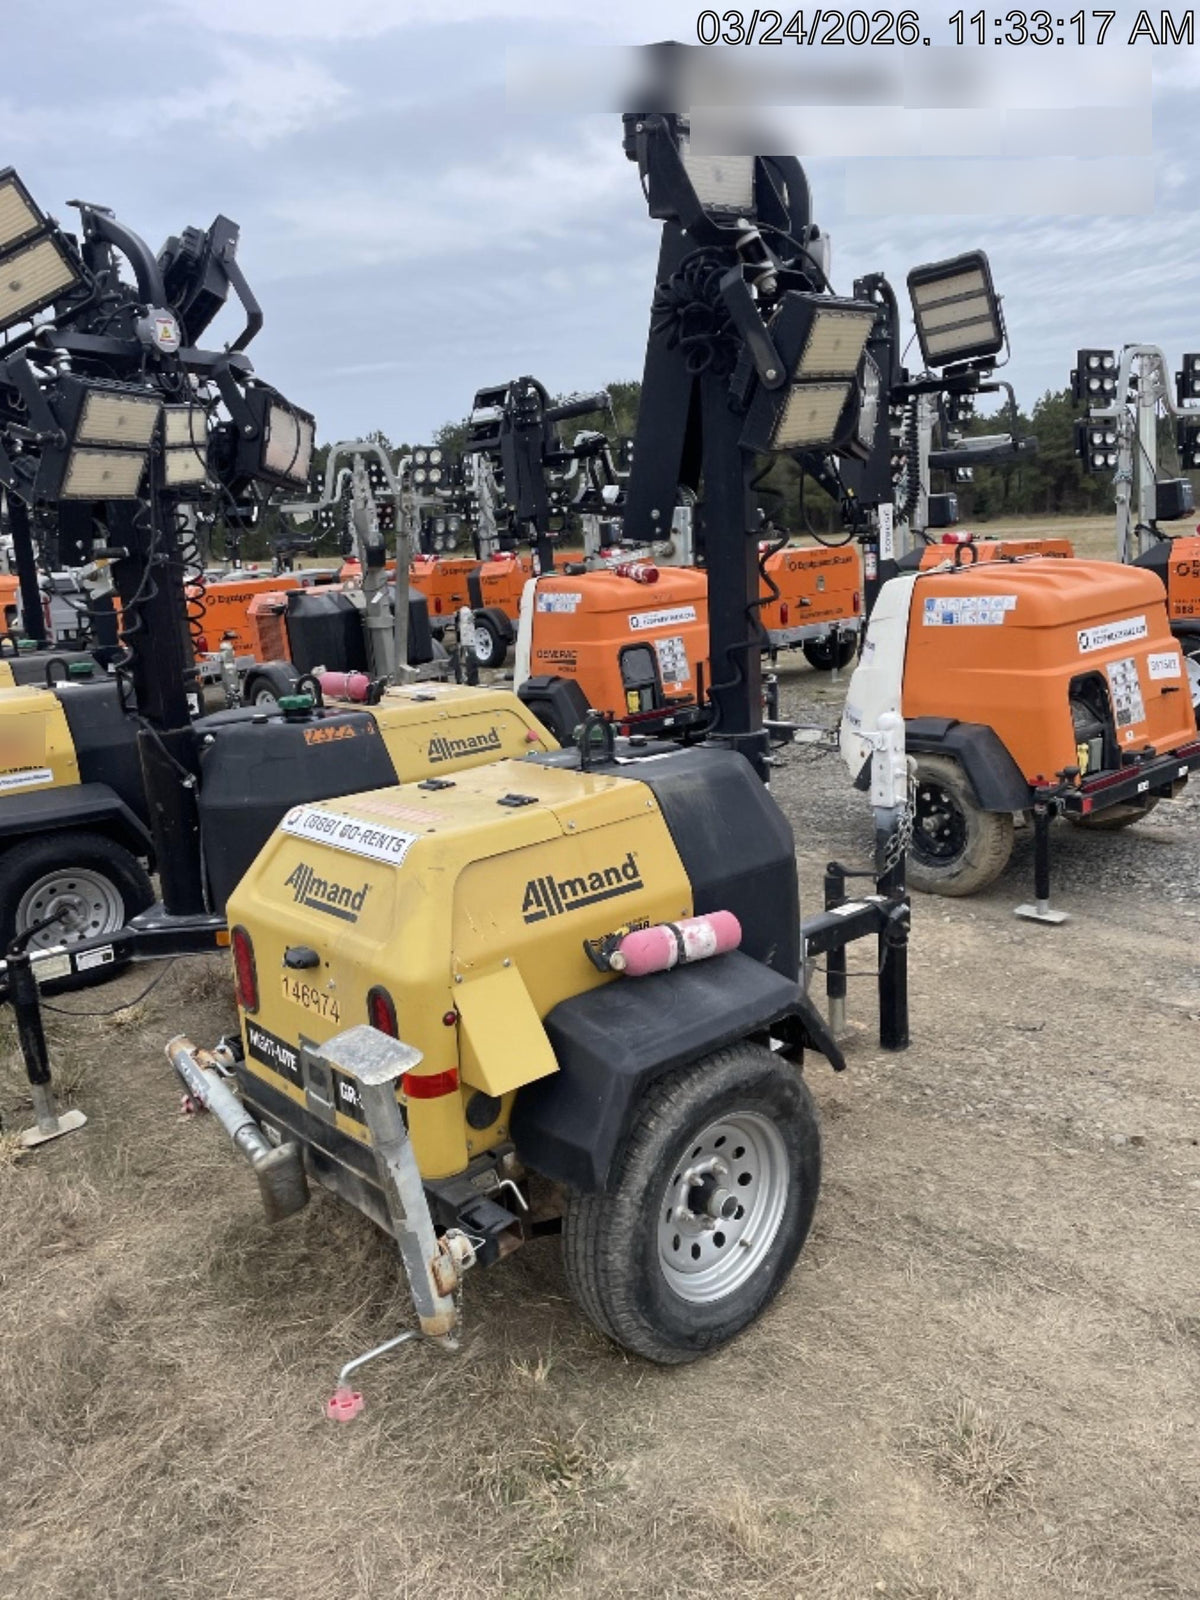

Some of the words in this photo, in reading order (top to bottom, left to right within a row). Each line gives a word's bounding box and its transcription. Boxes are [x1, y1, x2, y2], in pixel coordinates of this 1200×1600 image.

[428, 727, 501, 760] Allmand
[303, 813, 341, 836] (888)
[339, 823, 406, 853] GO-RENTS
[284, 862, 369, 913] Allmand
[522, 852, 640, 917] Allmand
[282, 976, 340, 1023] 146974
